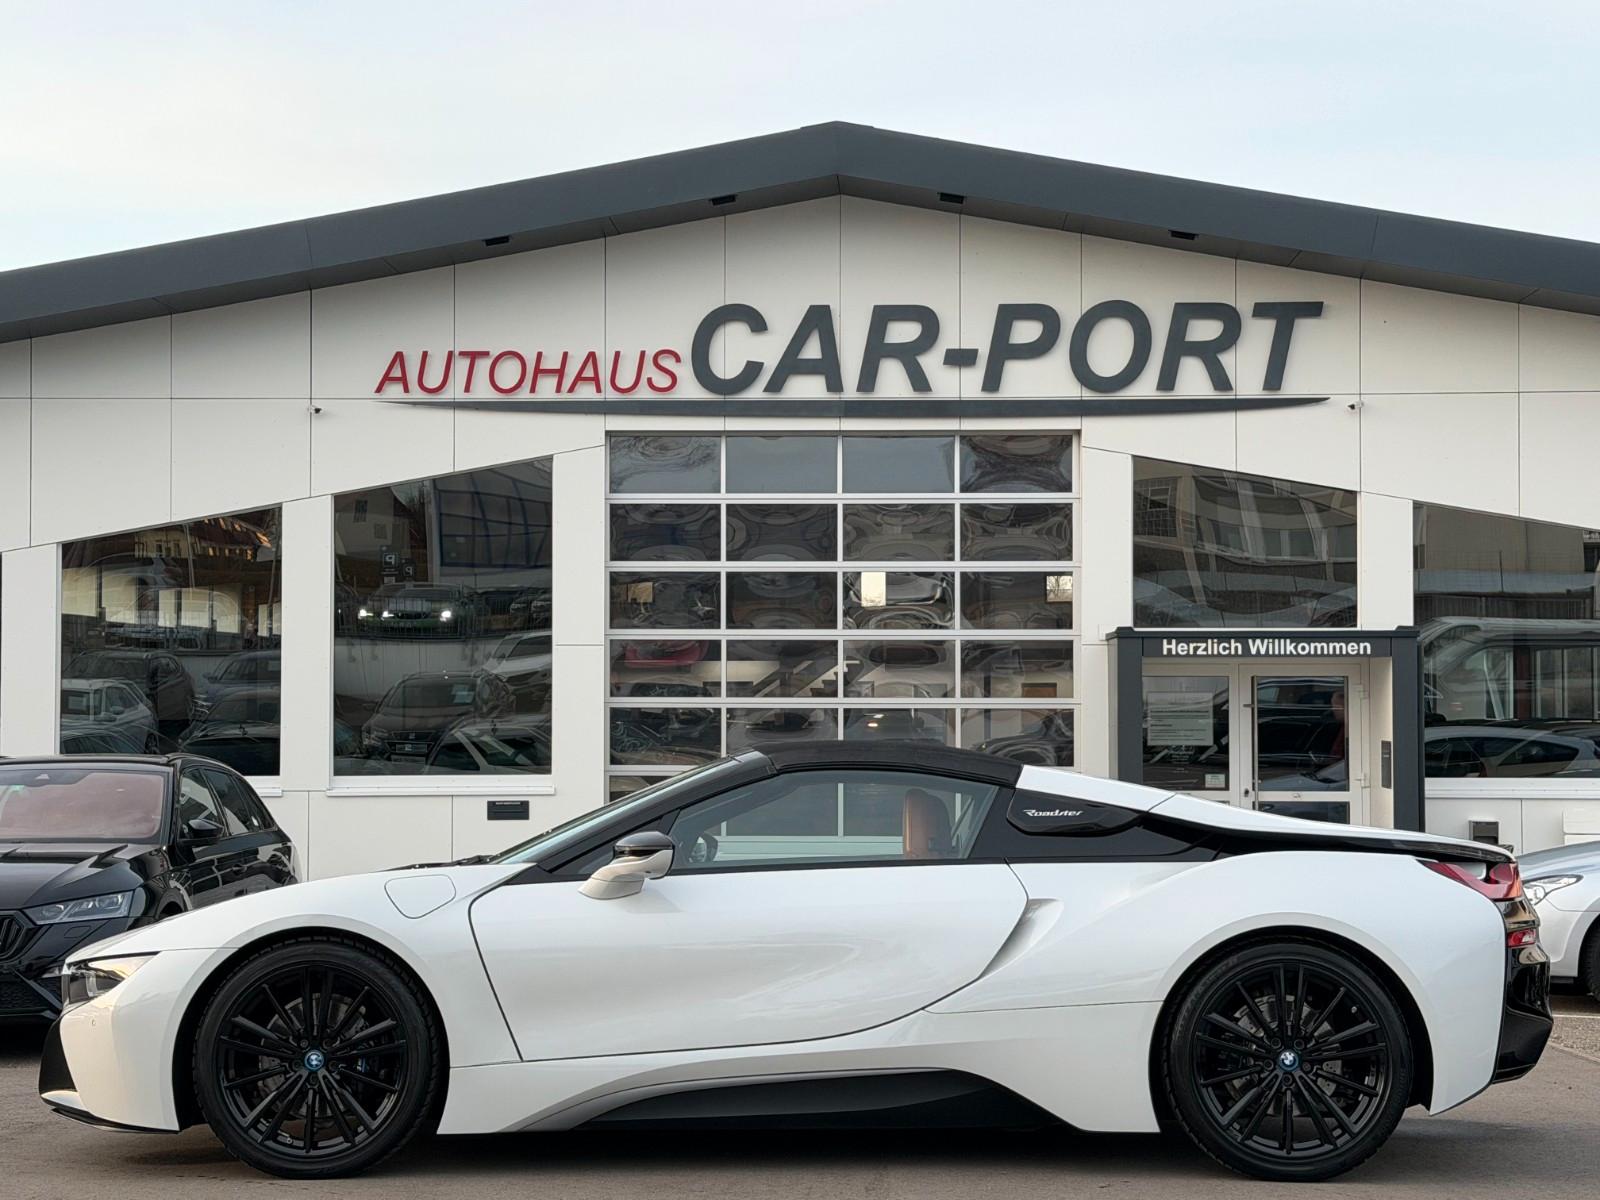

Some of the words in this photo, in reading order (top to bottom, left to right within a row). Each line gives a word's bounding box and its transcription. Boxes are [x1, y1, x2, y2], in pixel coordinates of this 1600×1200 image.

[374, 349, 682, 395] AUTOHAUS
[691, 299, 1324, 396] CAR-PORT
[1162, 638, 1242, 656] Herzlich
[1248, 638, 1372, 656] Willkommen
[1023, 808, 1084, 817] Roadster
